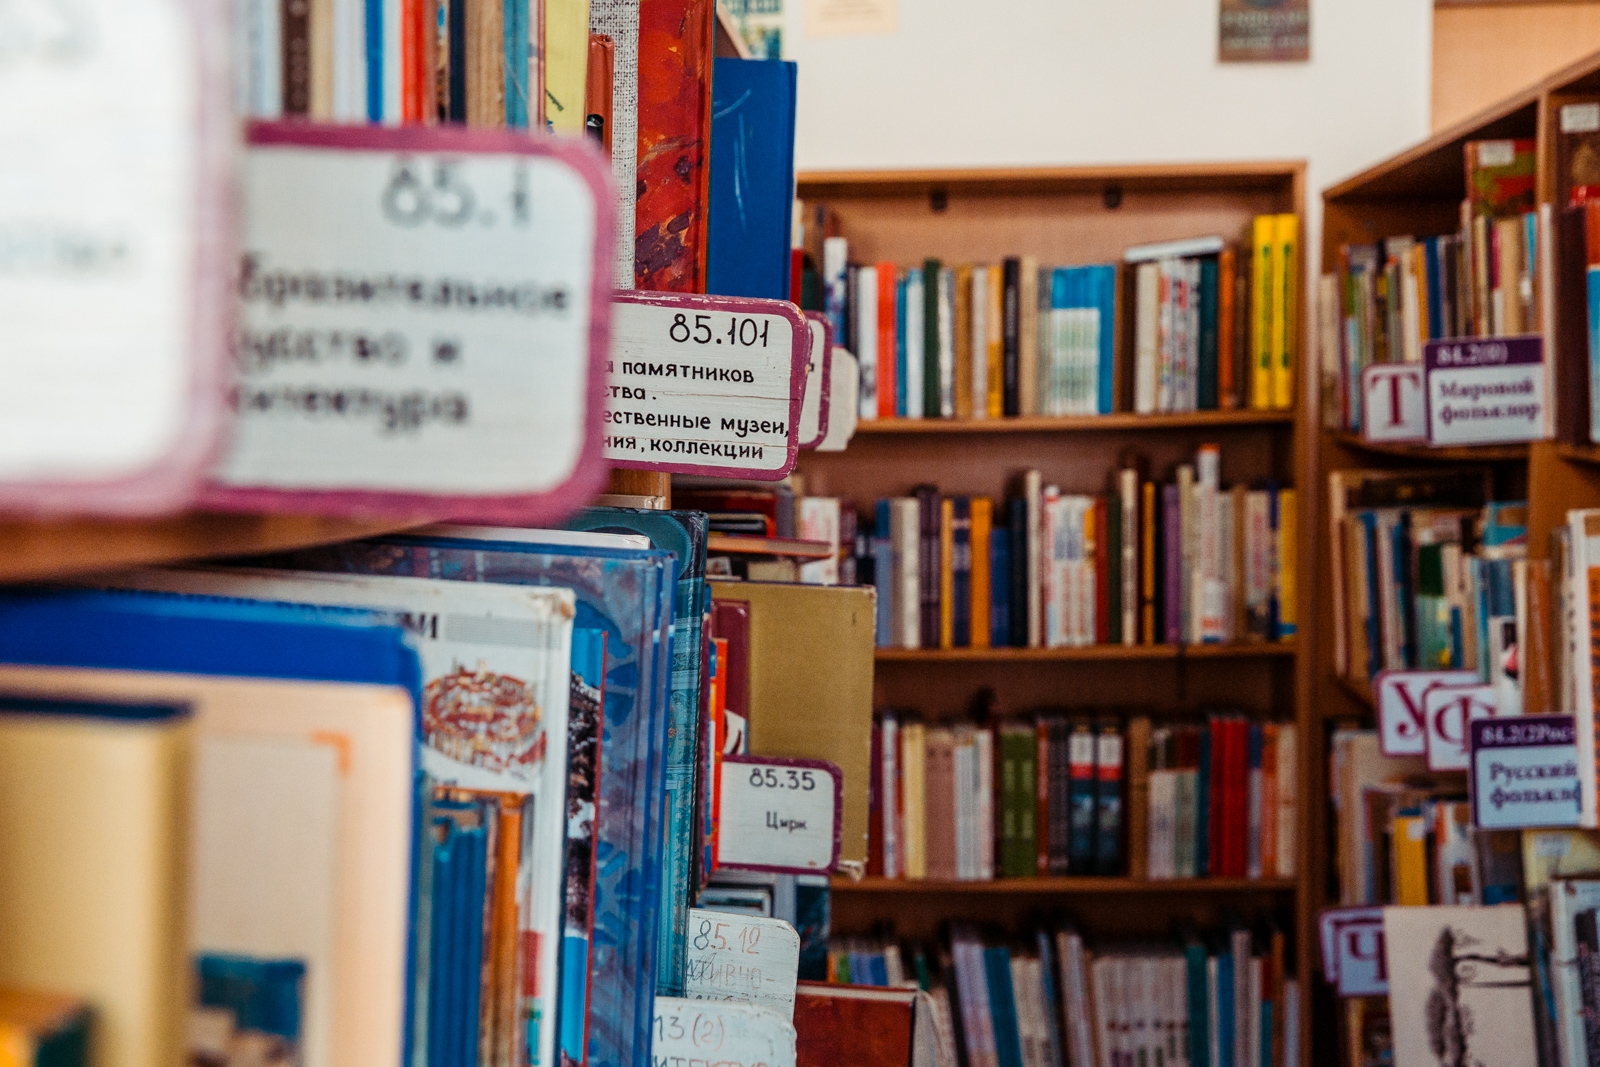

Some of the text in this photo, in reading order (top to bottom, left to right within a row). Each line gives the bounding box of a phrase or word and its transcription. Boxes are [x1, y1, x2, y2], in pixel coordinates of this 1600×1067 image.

[381, 155, 532, 228] 85.1
[669, 313, 769, 347] 85.101
[622, 361, 755, 383] памятников
[603, 410, 711, 430] ественные
[649, 437, 764, 460] коллекции
[748, 766, 816, 791] 85.35
[766, 810, 808, 834] Цирк
